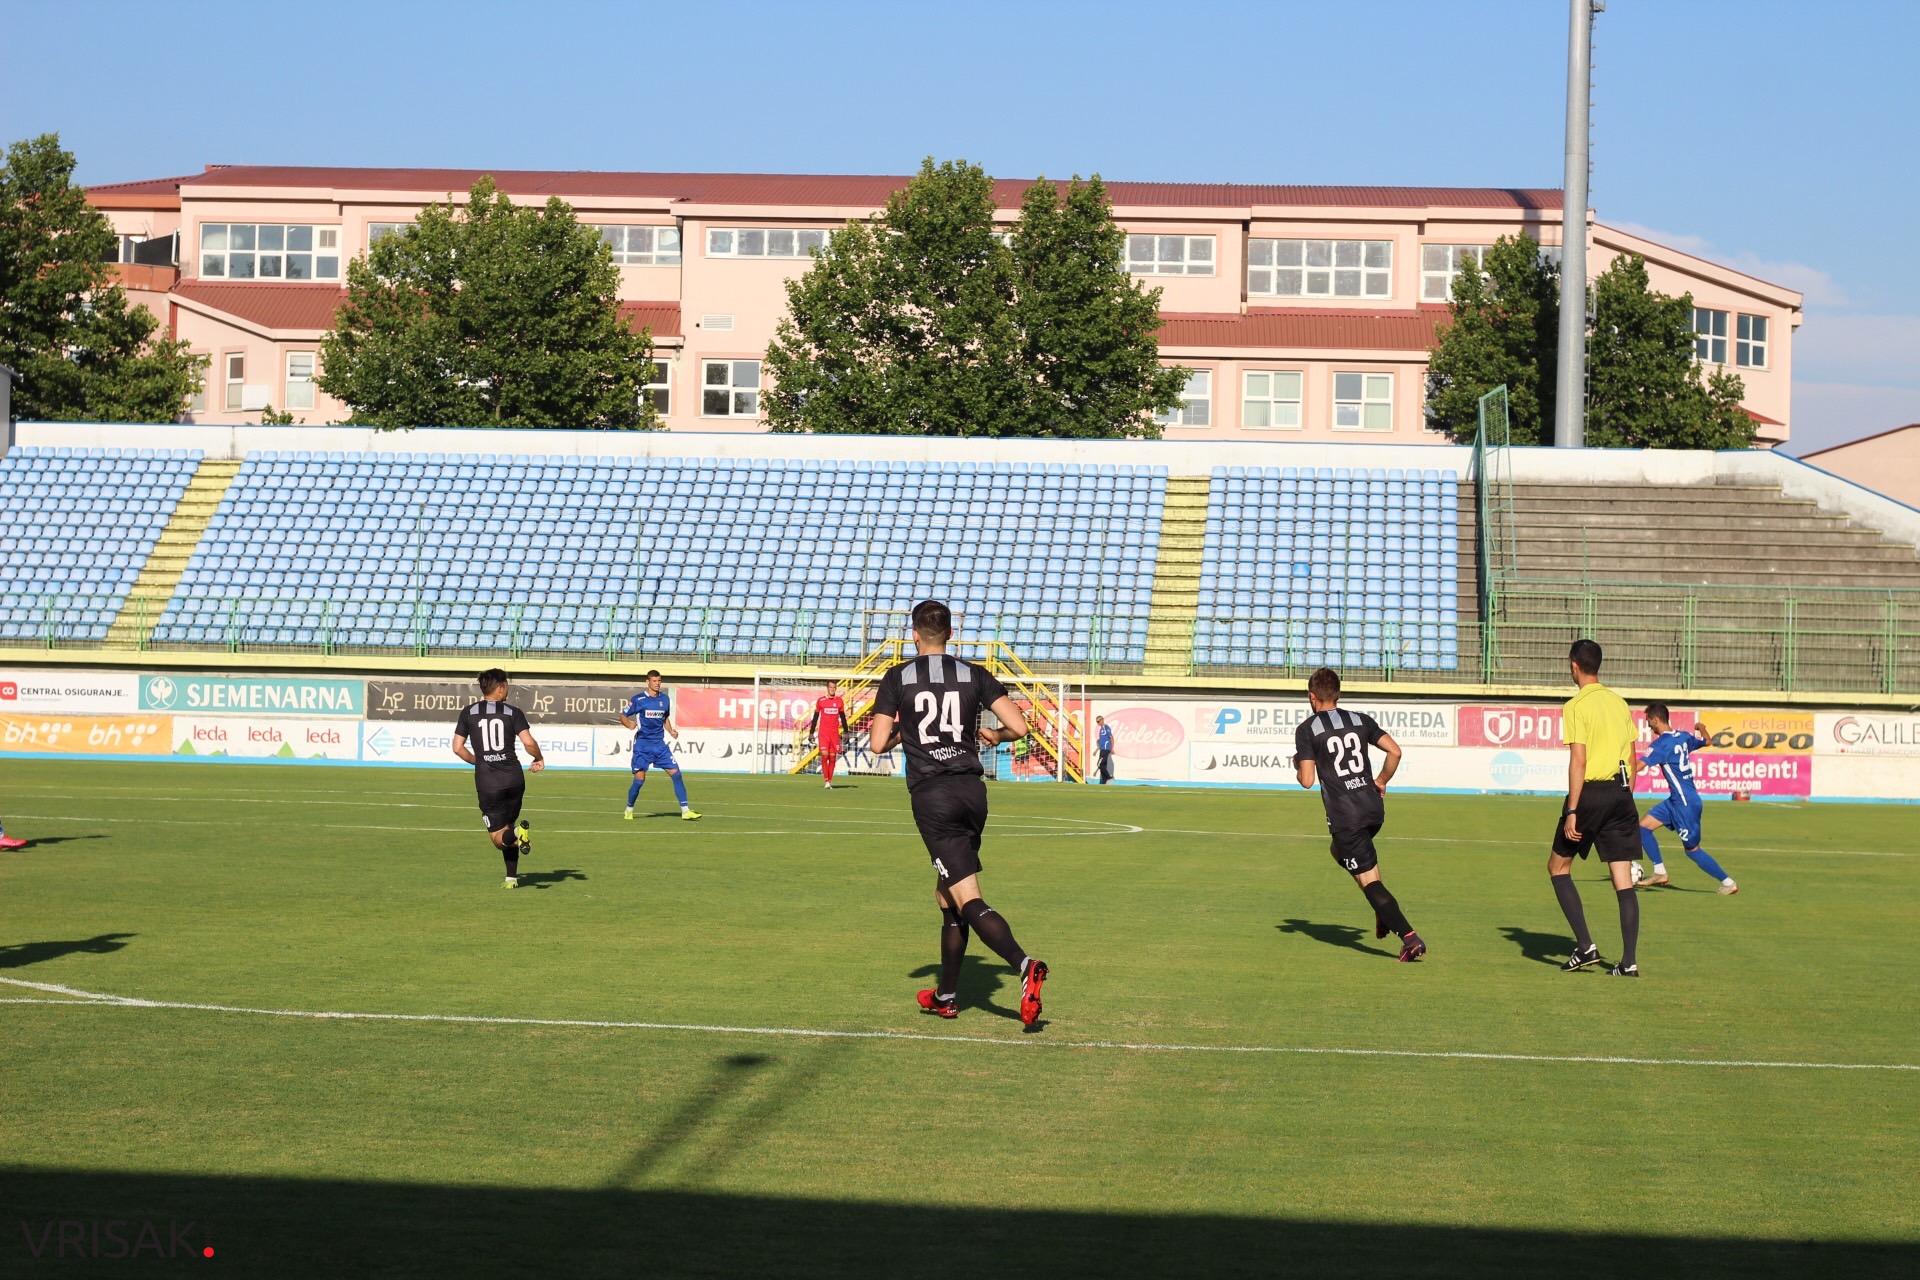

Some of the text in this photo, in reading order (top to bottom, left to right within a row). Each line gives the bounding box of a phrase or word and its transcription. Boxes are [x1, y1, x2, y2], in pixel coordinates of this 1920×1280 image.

[21, 687, 122, 697] CENTRAL OSIGURANJE
[186, 683, 353, 710] SJEMENARNA
[414, 694, 464, 711] HOTEL
[564, 697, 615, 713] HOTEL
[914, 690, 964, 745] 24
[1247, 708, 1268, 726] JP
[1742, 718, 1814, 731] reklame
[193, 725, 228, 742] leda
[248, 726, 282, 743] leda
[306, 728, 341, 744] leda
[478, 718, 505, 752] 10
[1247, 727, 1289, 736] HRVATSKE
[1420, 730, 1449, 738] Mostar
[1222, 754, 1294, 769] JABUKA.T
[1326, 732, 1364, 777] 23
[1707, 759, 1798, 780] student!
